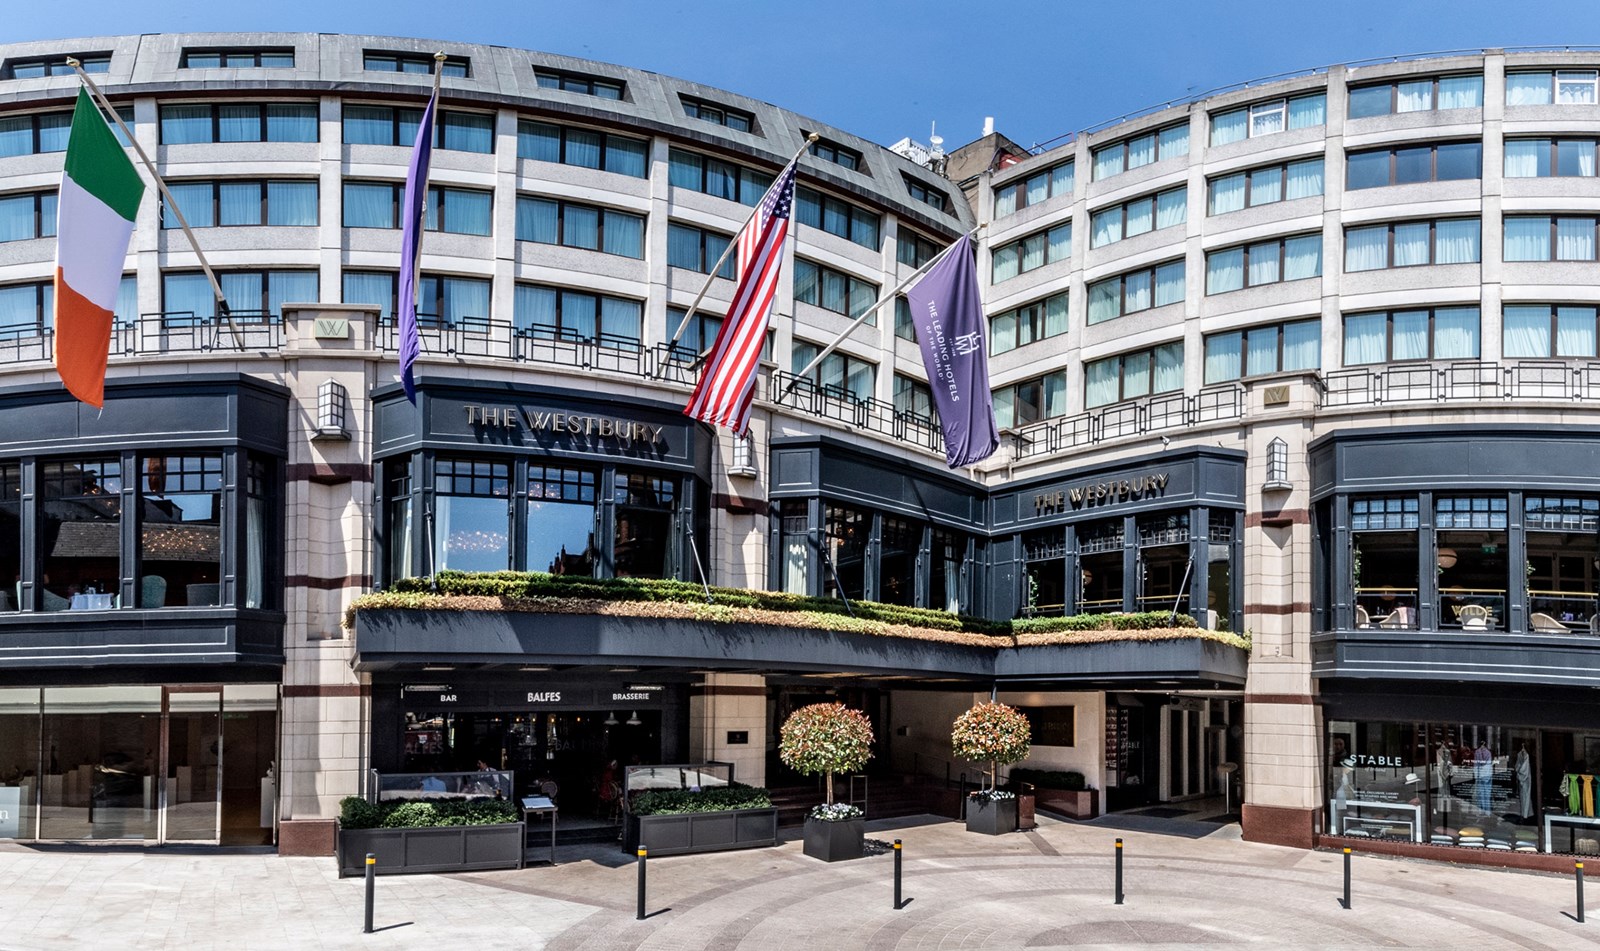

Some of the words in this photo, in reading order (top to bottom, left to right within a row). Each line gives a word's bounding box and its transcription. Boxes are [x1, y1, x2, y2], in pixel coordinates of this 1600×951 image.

[927, 300, 938, 319] THE
[926, 325, 932, 334] OF
[932, 319, 950, 361] LEADING
[944, 364, 960, 402] HOTELS
[464, 405, 517, 427] THE
[526, 411, 663, 443] WESTBURY
[1034, 491, 1065, 509] THE
[1069, 473, 1169, 503] WESTBURY
[1451, 605, 1493, 616] WILDE
[440, 694, 457, 702] BAR
[527, 692, 561, 702] BALFES
[1350, 754, 1402, 766] STABLE
